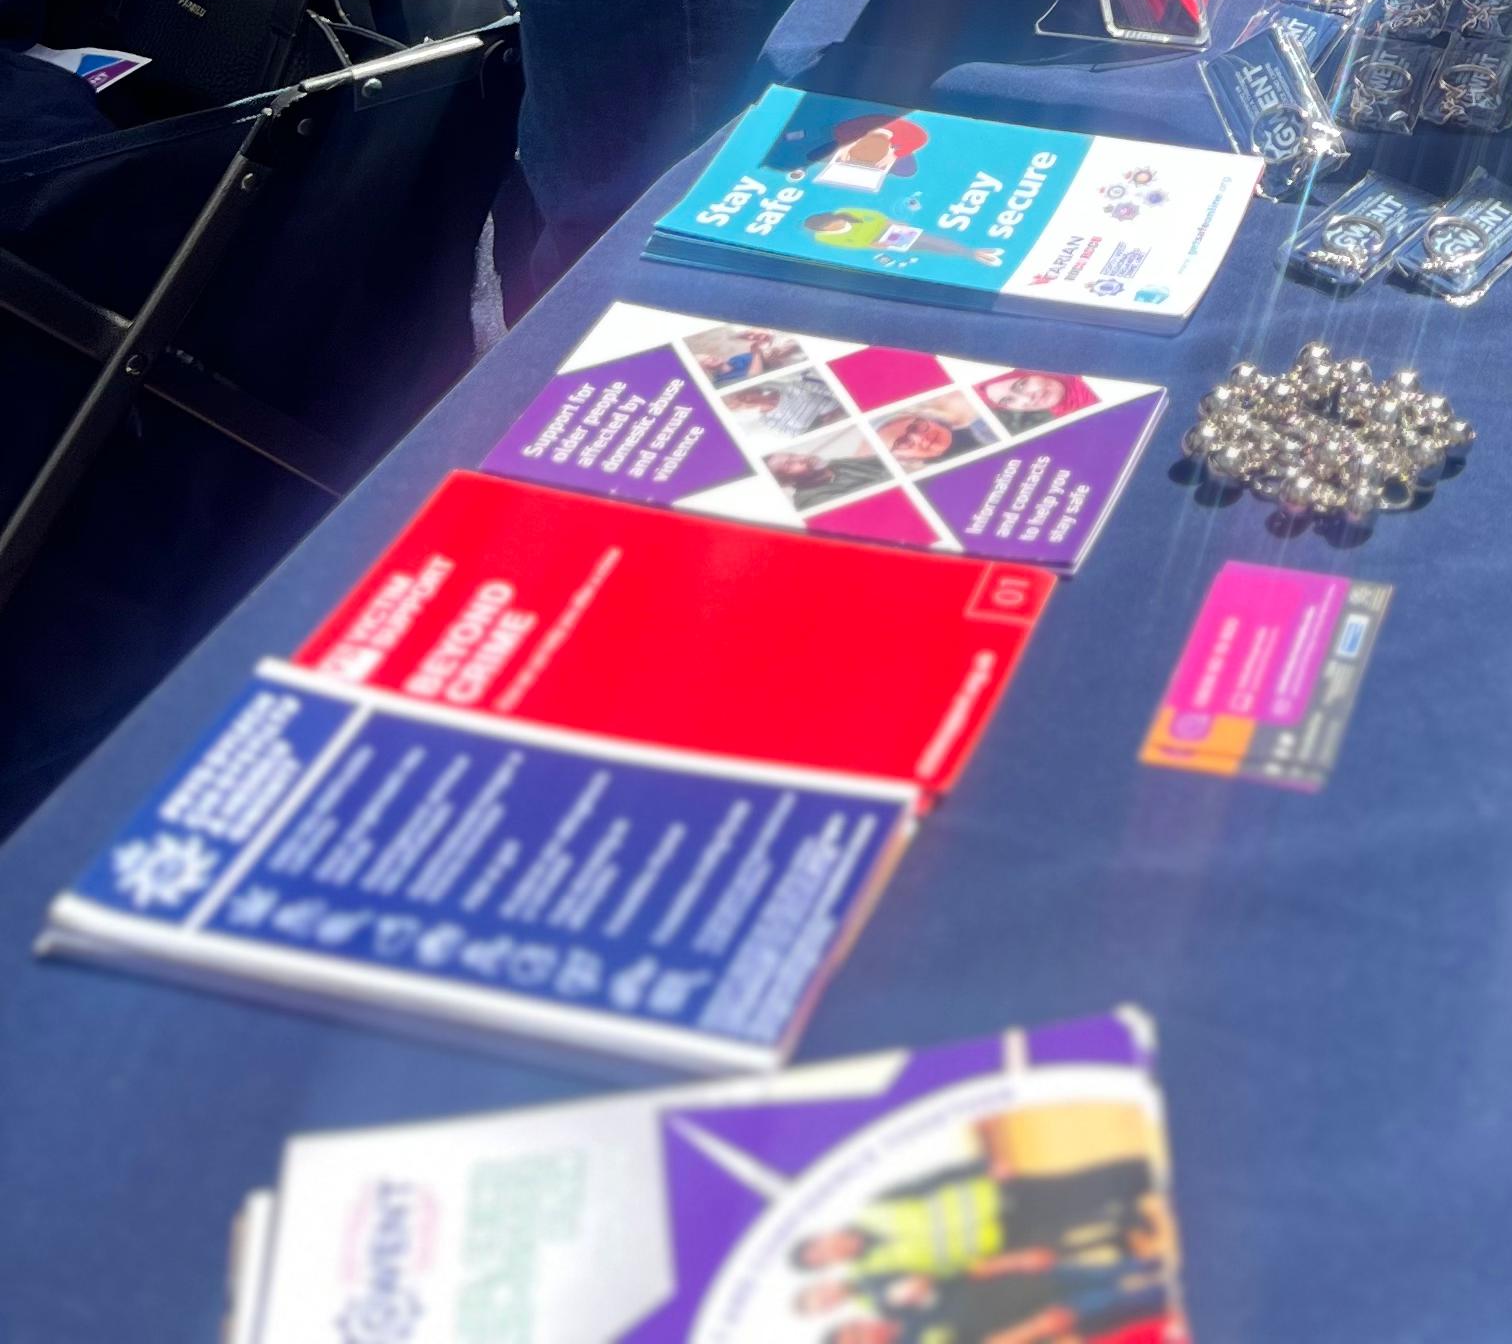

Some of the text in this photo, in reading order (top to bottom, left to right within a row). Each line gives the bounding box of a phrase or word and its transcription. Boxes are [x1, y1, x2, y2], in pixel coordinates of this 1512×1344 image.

[1242, 64, 1297, 148] GWENT
[696, 175, 766, 226] Stay
[745, 186, 803, 235] safe
[937, 171, 1002, 231] Stay
[988, 151, 1056, 238] secure
[522, 382, 595, 457] Support for
[552, 381, 626, 462] older people
[578, 394, 646, 467] affected by
[601, 378, 684, 472] domestic abuse
[628, 405, 692, 477] and sexual
[654, 426, 704, 481] violence
[966, 459, 1020, 534] Information
[996, 456, 1050, 538] and contacts
[1019, 469, 1070, 541] to help you
[1048, 484, 1090, 542] stay safe
[367, 556, 451, 647] SUPPORT
[408, 583, 510, 694] BEYOND
[447, 614, 531, 701] CRIME
